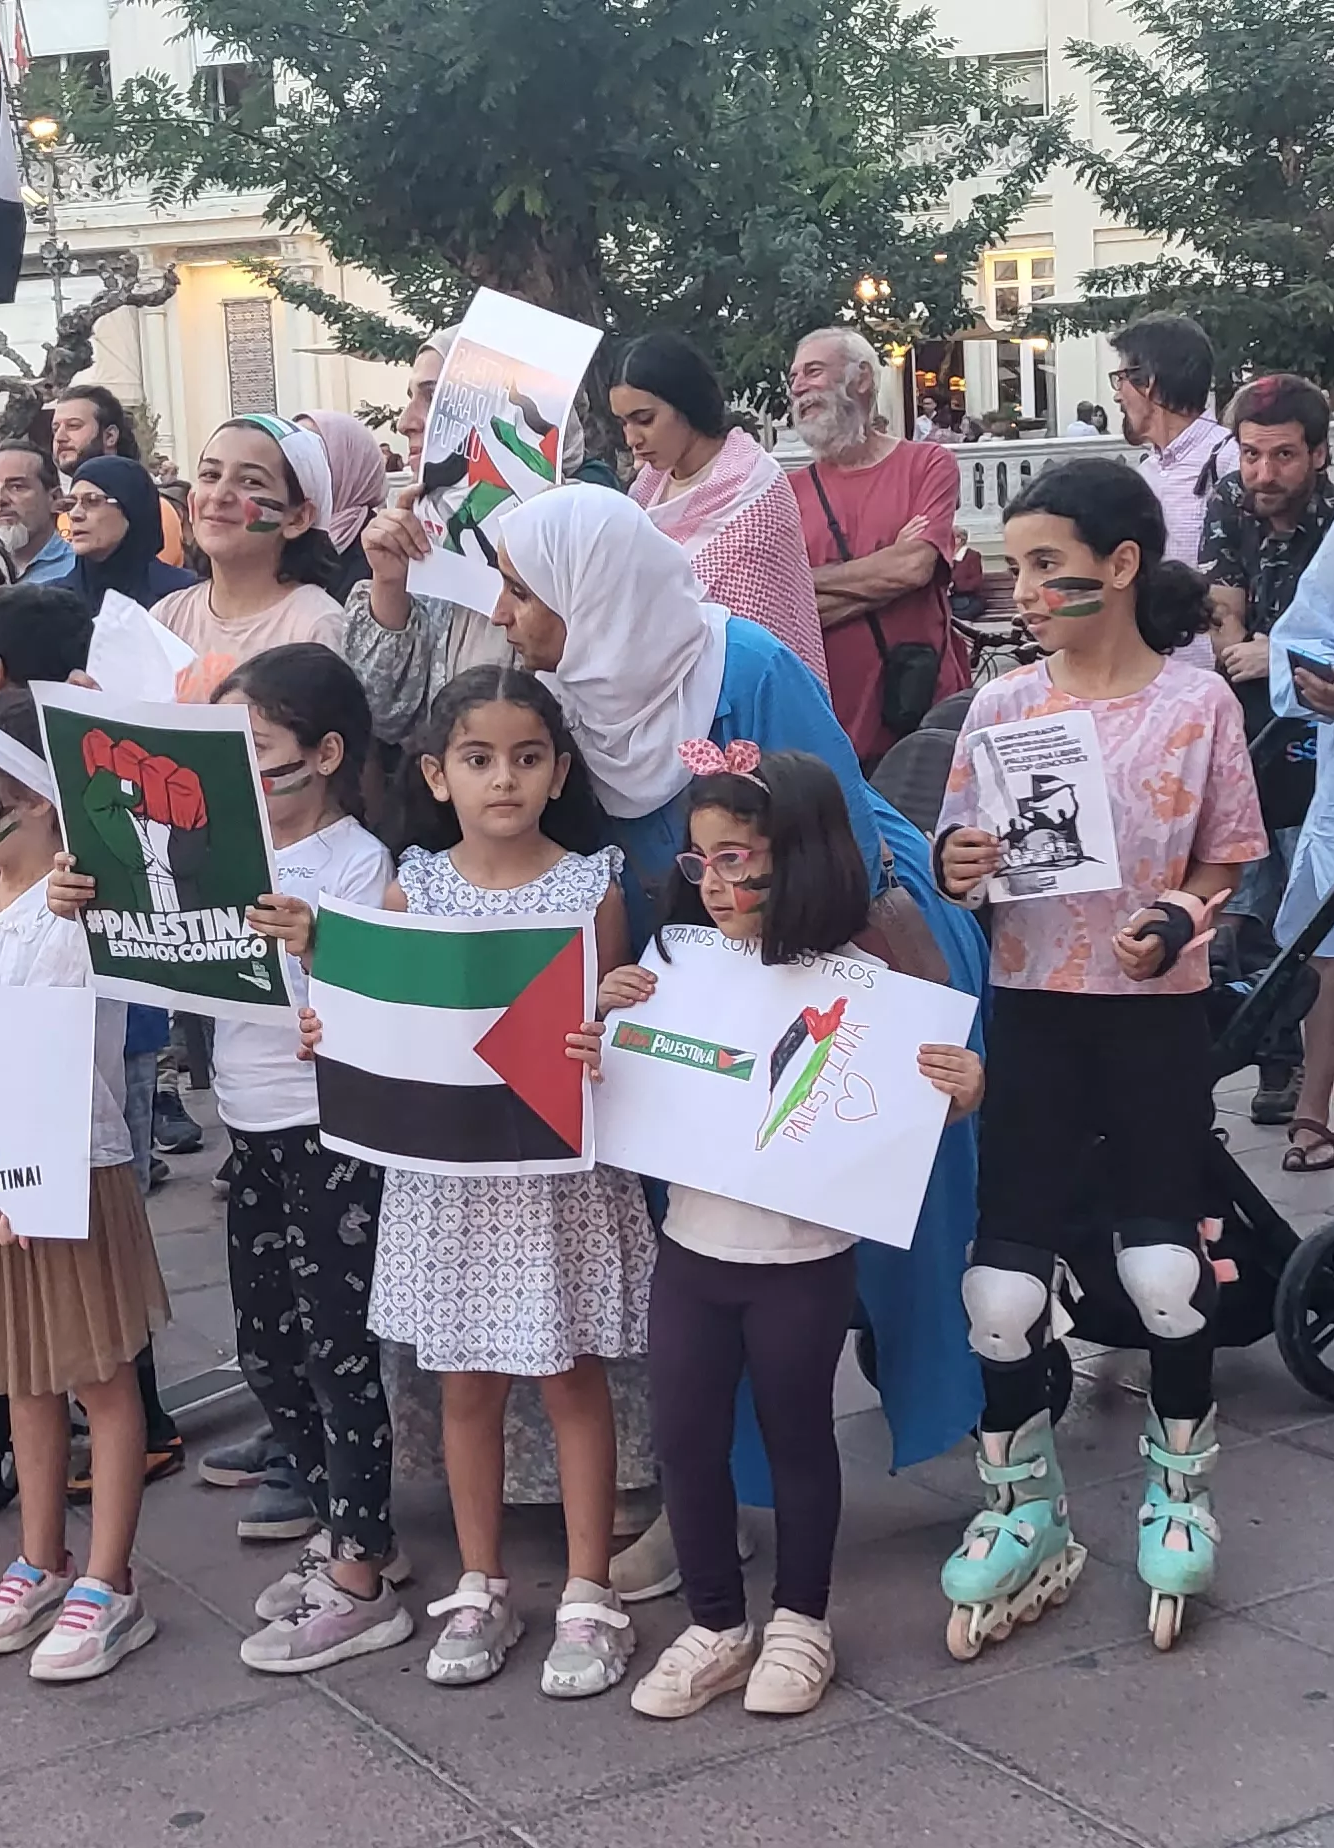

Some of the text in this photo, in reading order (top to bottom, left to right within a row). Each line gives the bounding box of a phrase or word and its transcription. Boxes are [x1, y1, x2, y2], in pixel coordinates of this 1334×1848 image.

[440, 382, 492, 428] PARA SU
[433, 413, 483, 463] PUEBLO
[85, 905, 268, 945] #PALESTINA
[663, 927, 718, 947] STAMOS
[722, 937, 758, 957] CON
[107, 937, 268, 963] ESTAMOS CONTIGO
[650, 1033, 716, 1066] PALESTINA
[782, 1021, 871, 1144] PALESTINA
